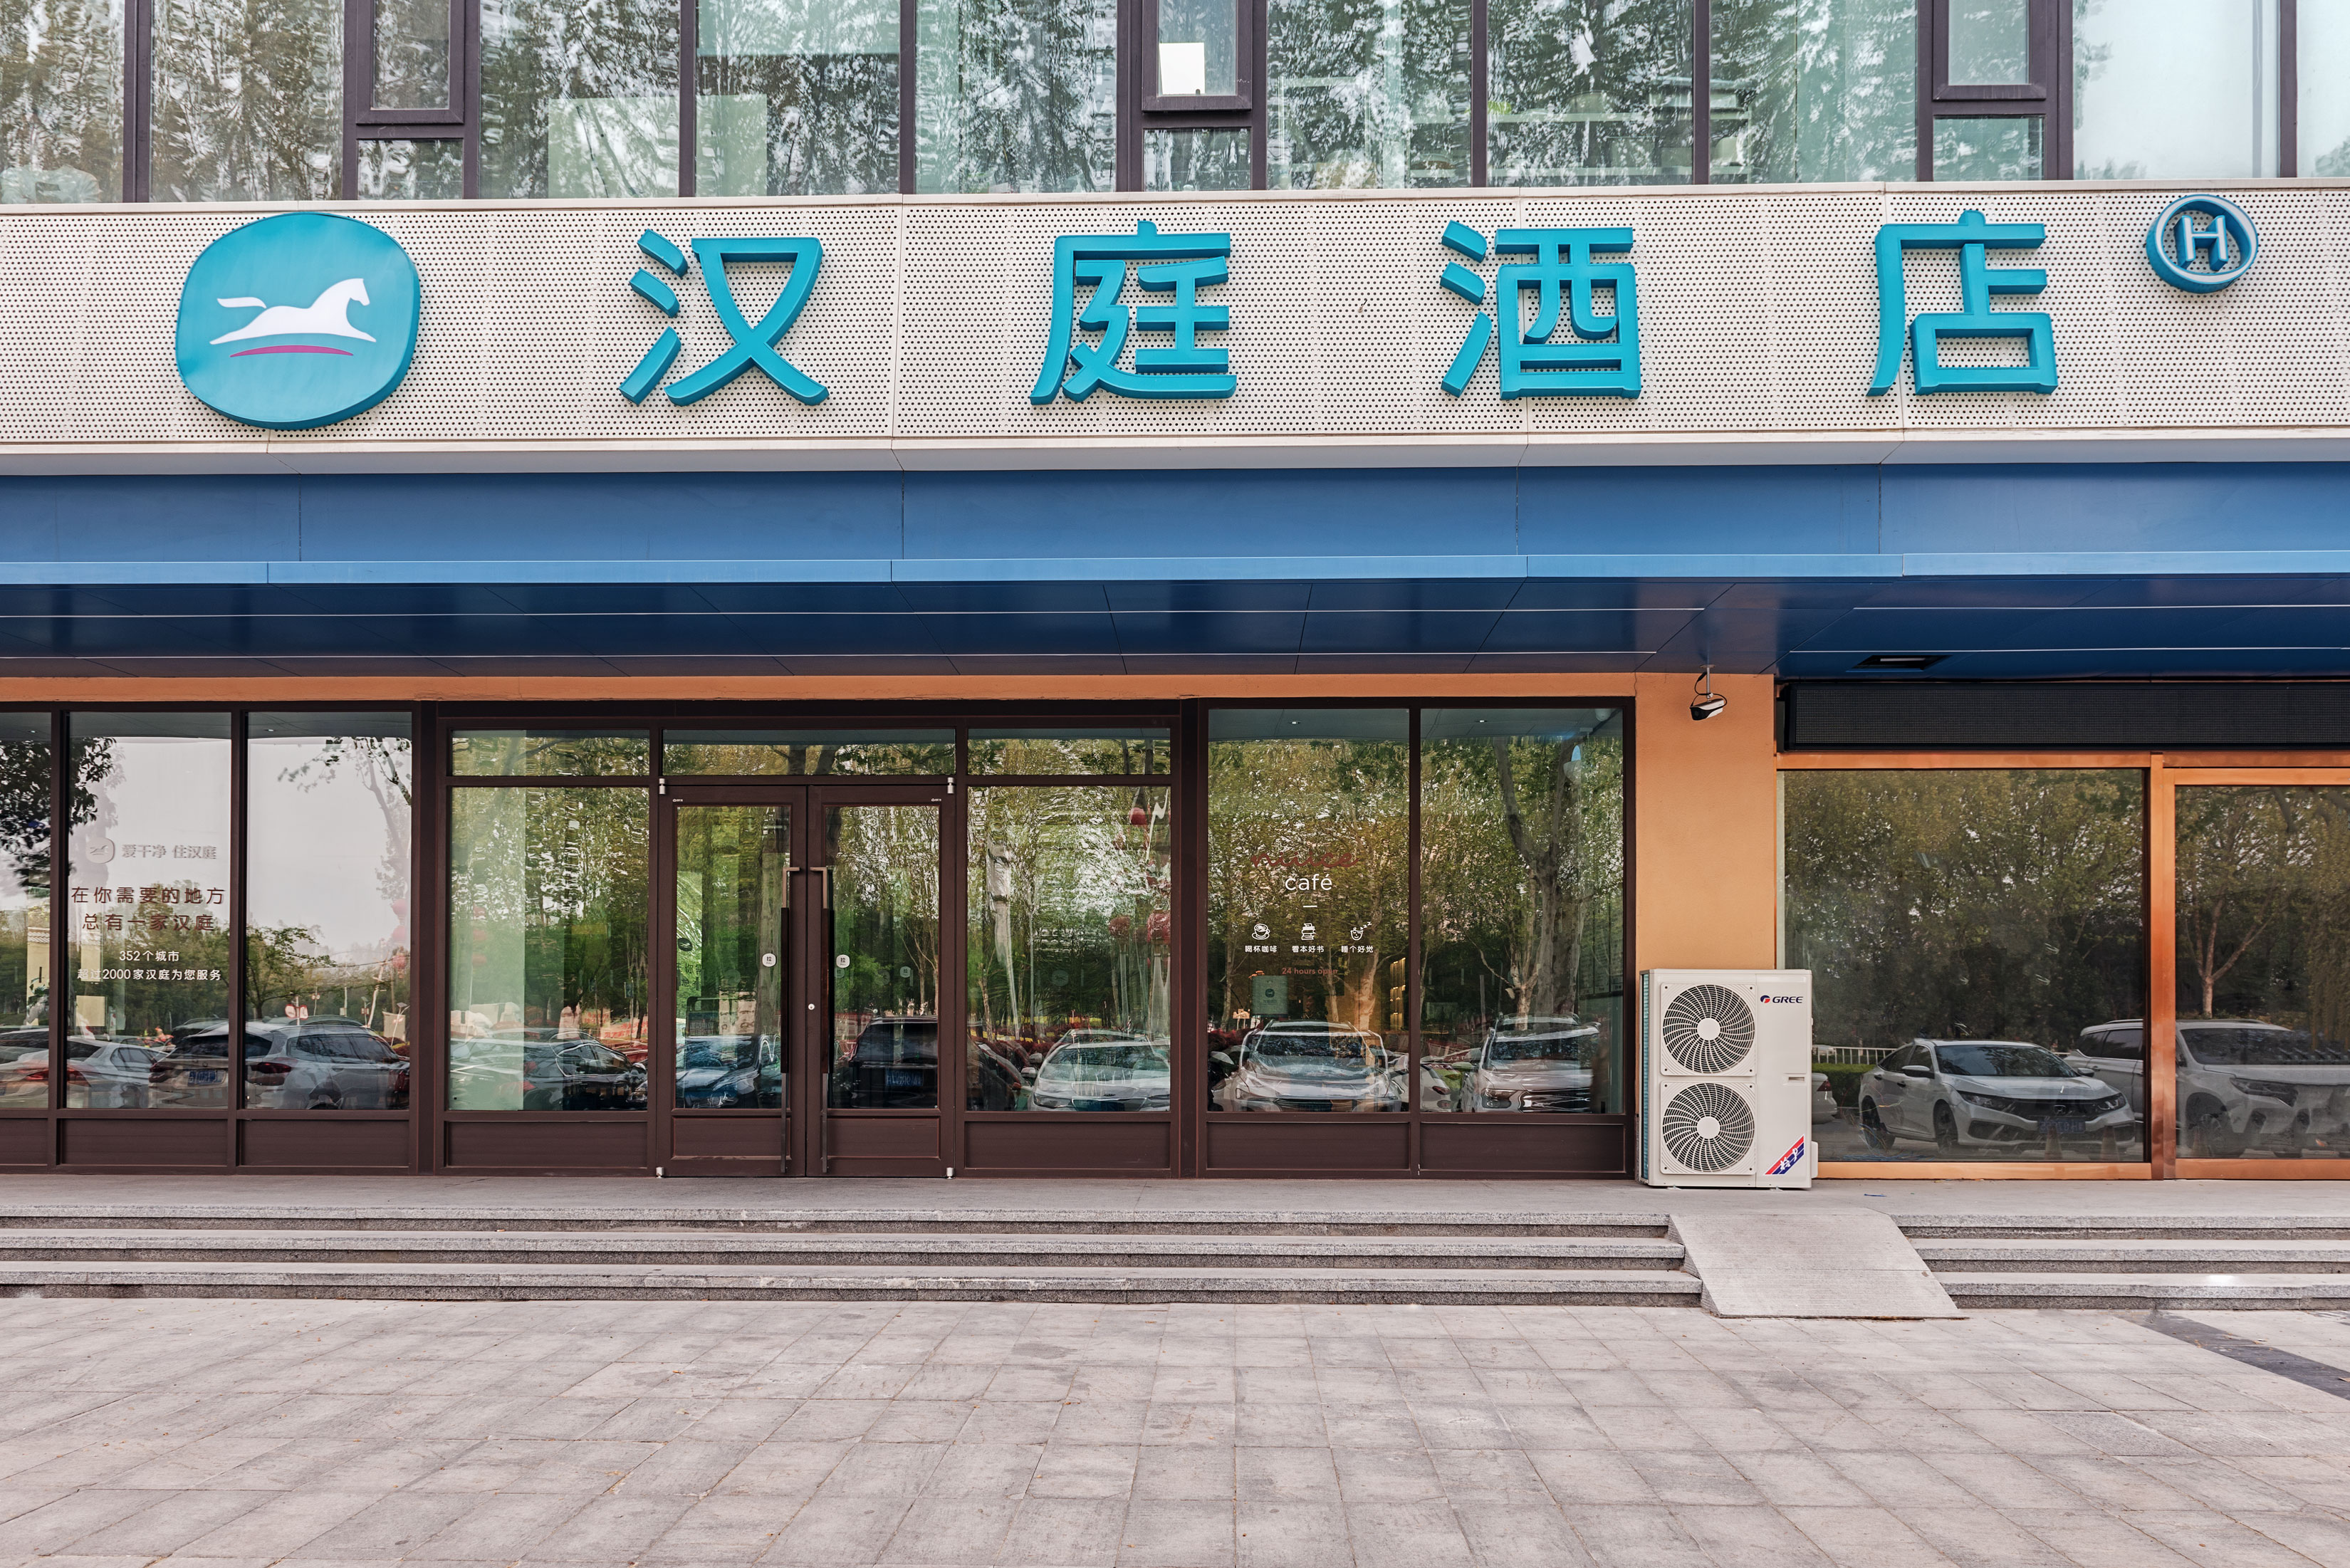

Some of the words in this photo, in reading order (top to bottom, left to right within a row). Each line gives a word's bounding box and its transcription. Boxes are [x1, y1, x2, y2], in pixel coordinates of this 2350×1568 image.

[2173, 214, 2229, 271] H
[619, 209, 2058, 406] 汉庭酒店
[122, 844, 167, 859] 爱干净
[172, 845, 217, 859] 住汉庭
[1285, 873, 1332, 891] café
[71, 887, 225, 904] 在你需要的地方
[82, 913, 214, 931] 总有一家汉庭
[1245, 945, 1278, 953] 喝杯咖啡
[1291, 945, 1325, 953] 看本好书
[1341, 945, 1374, 953] 睡个好觉
[119, 950, 180, 962] 352个城市
[77, 969, 221, 981] 超过2000家汉庭为您服务
[1772, 995, 1804, 1004] GREE
